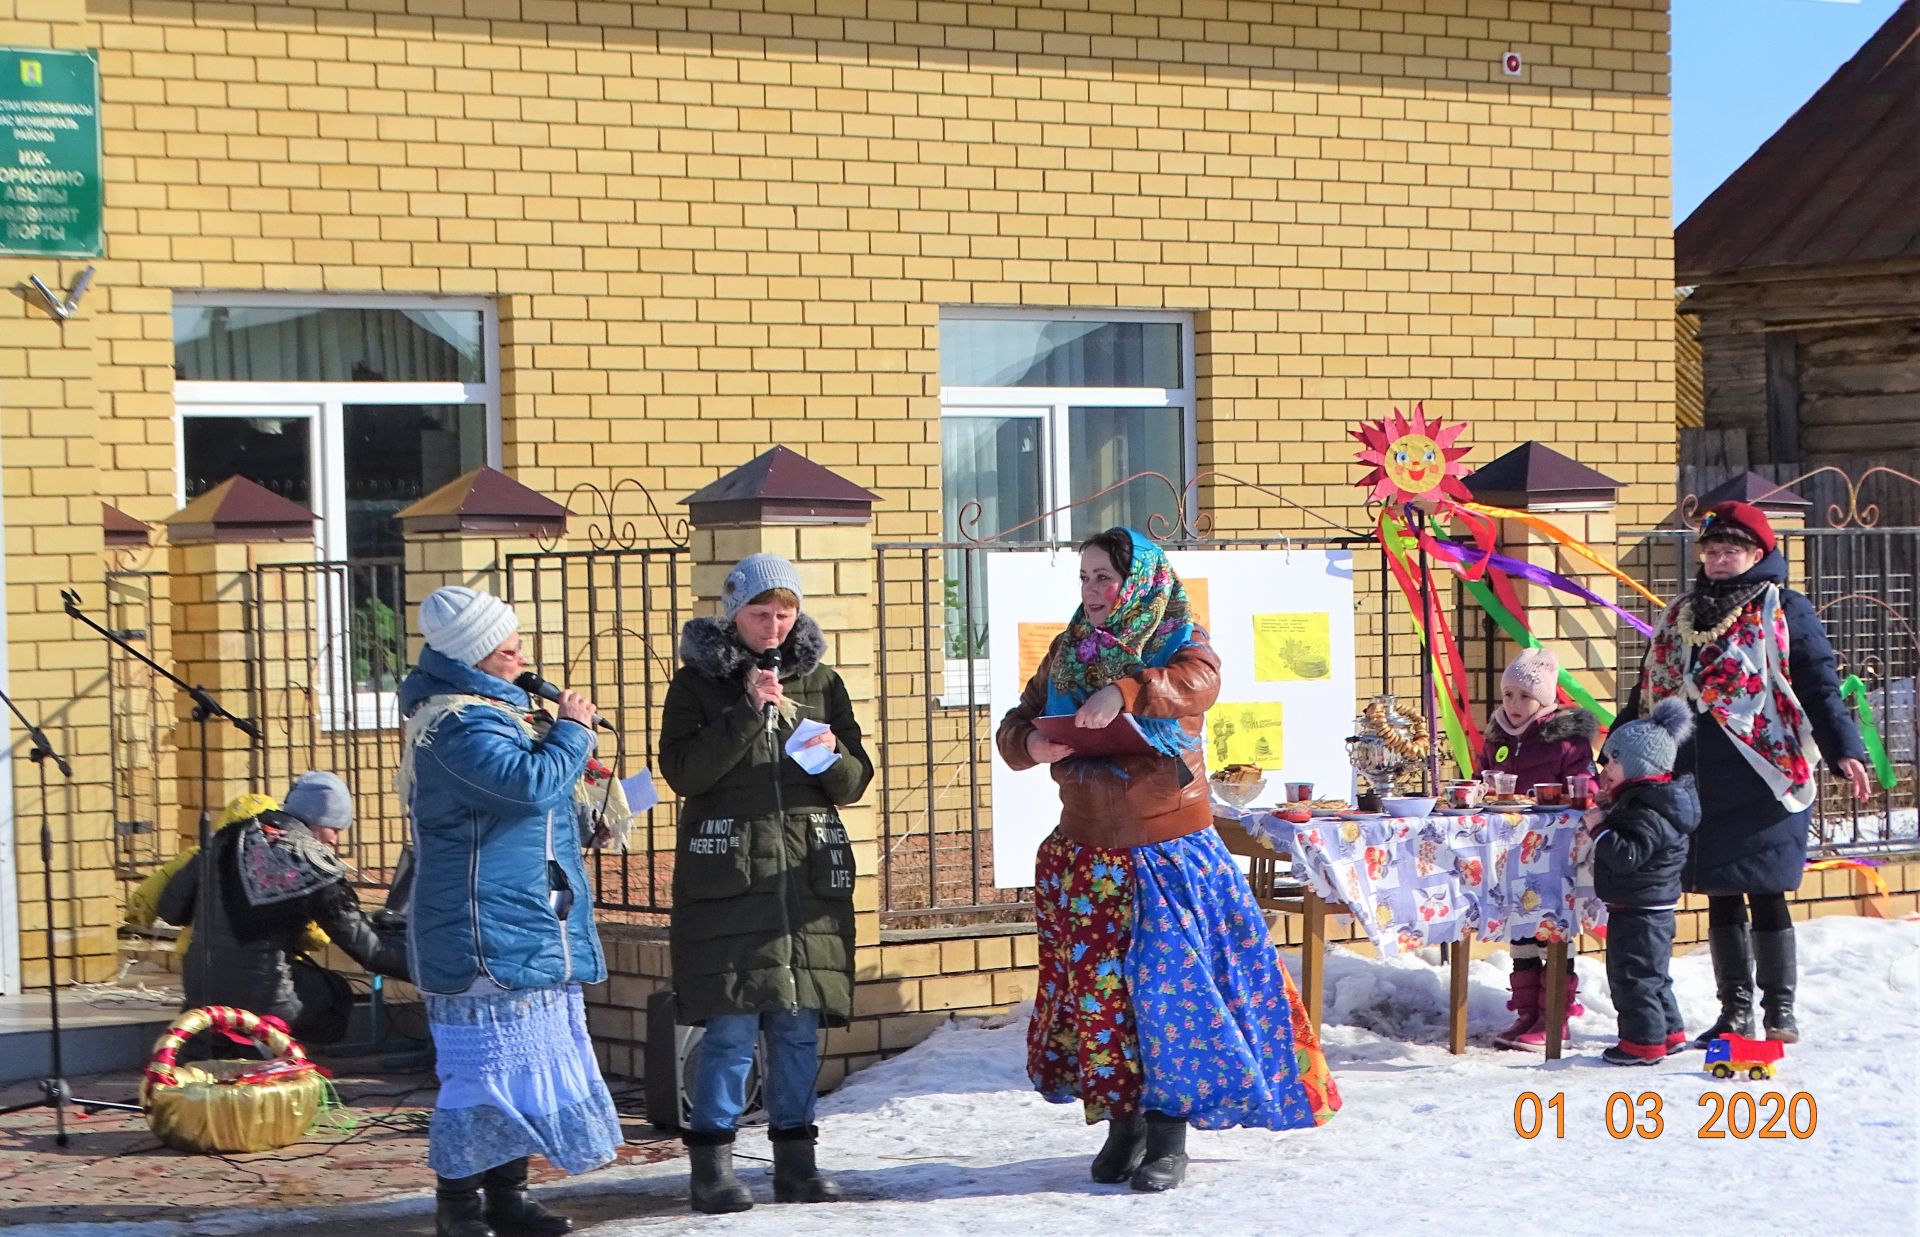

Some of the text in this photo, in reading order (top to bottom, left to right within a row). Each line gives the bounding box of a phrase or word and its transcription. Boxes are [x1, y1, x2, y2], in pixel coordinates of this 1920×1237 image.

[0, 167, 84, 187] ОРИСКИНО
[714, 818, 734, 836] NOT
[689, 837, 714, 855] HERE
[715, 838, 728, 855] TO
[830, 849, 843, 866] MY
[831, 869, 852, 888] LIFE
